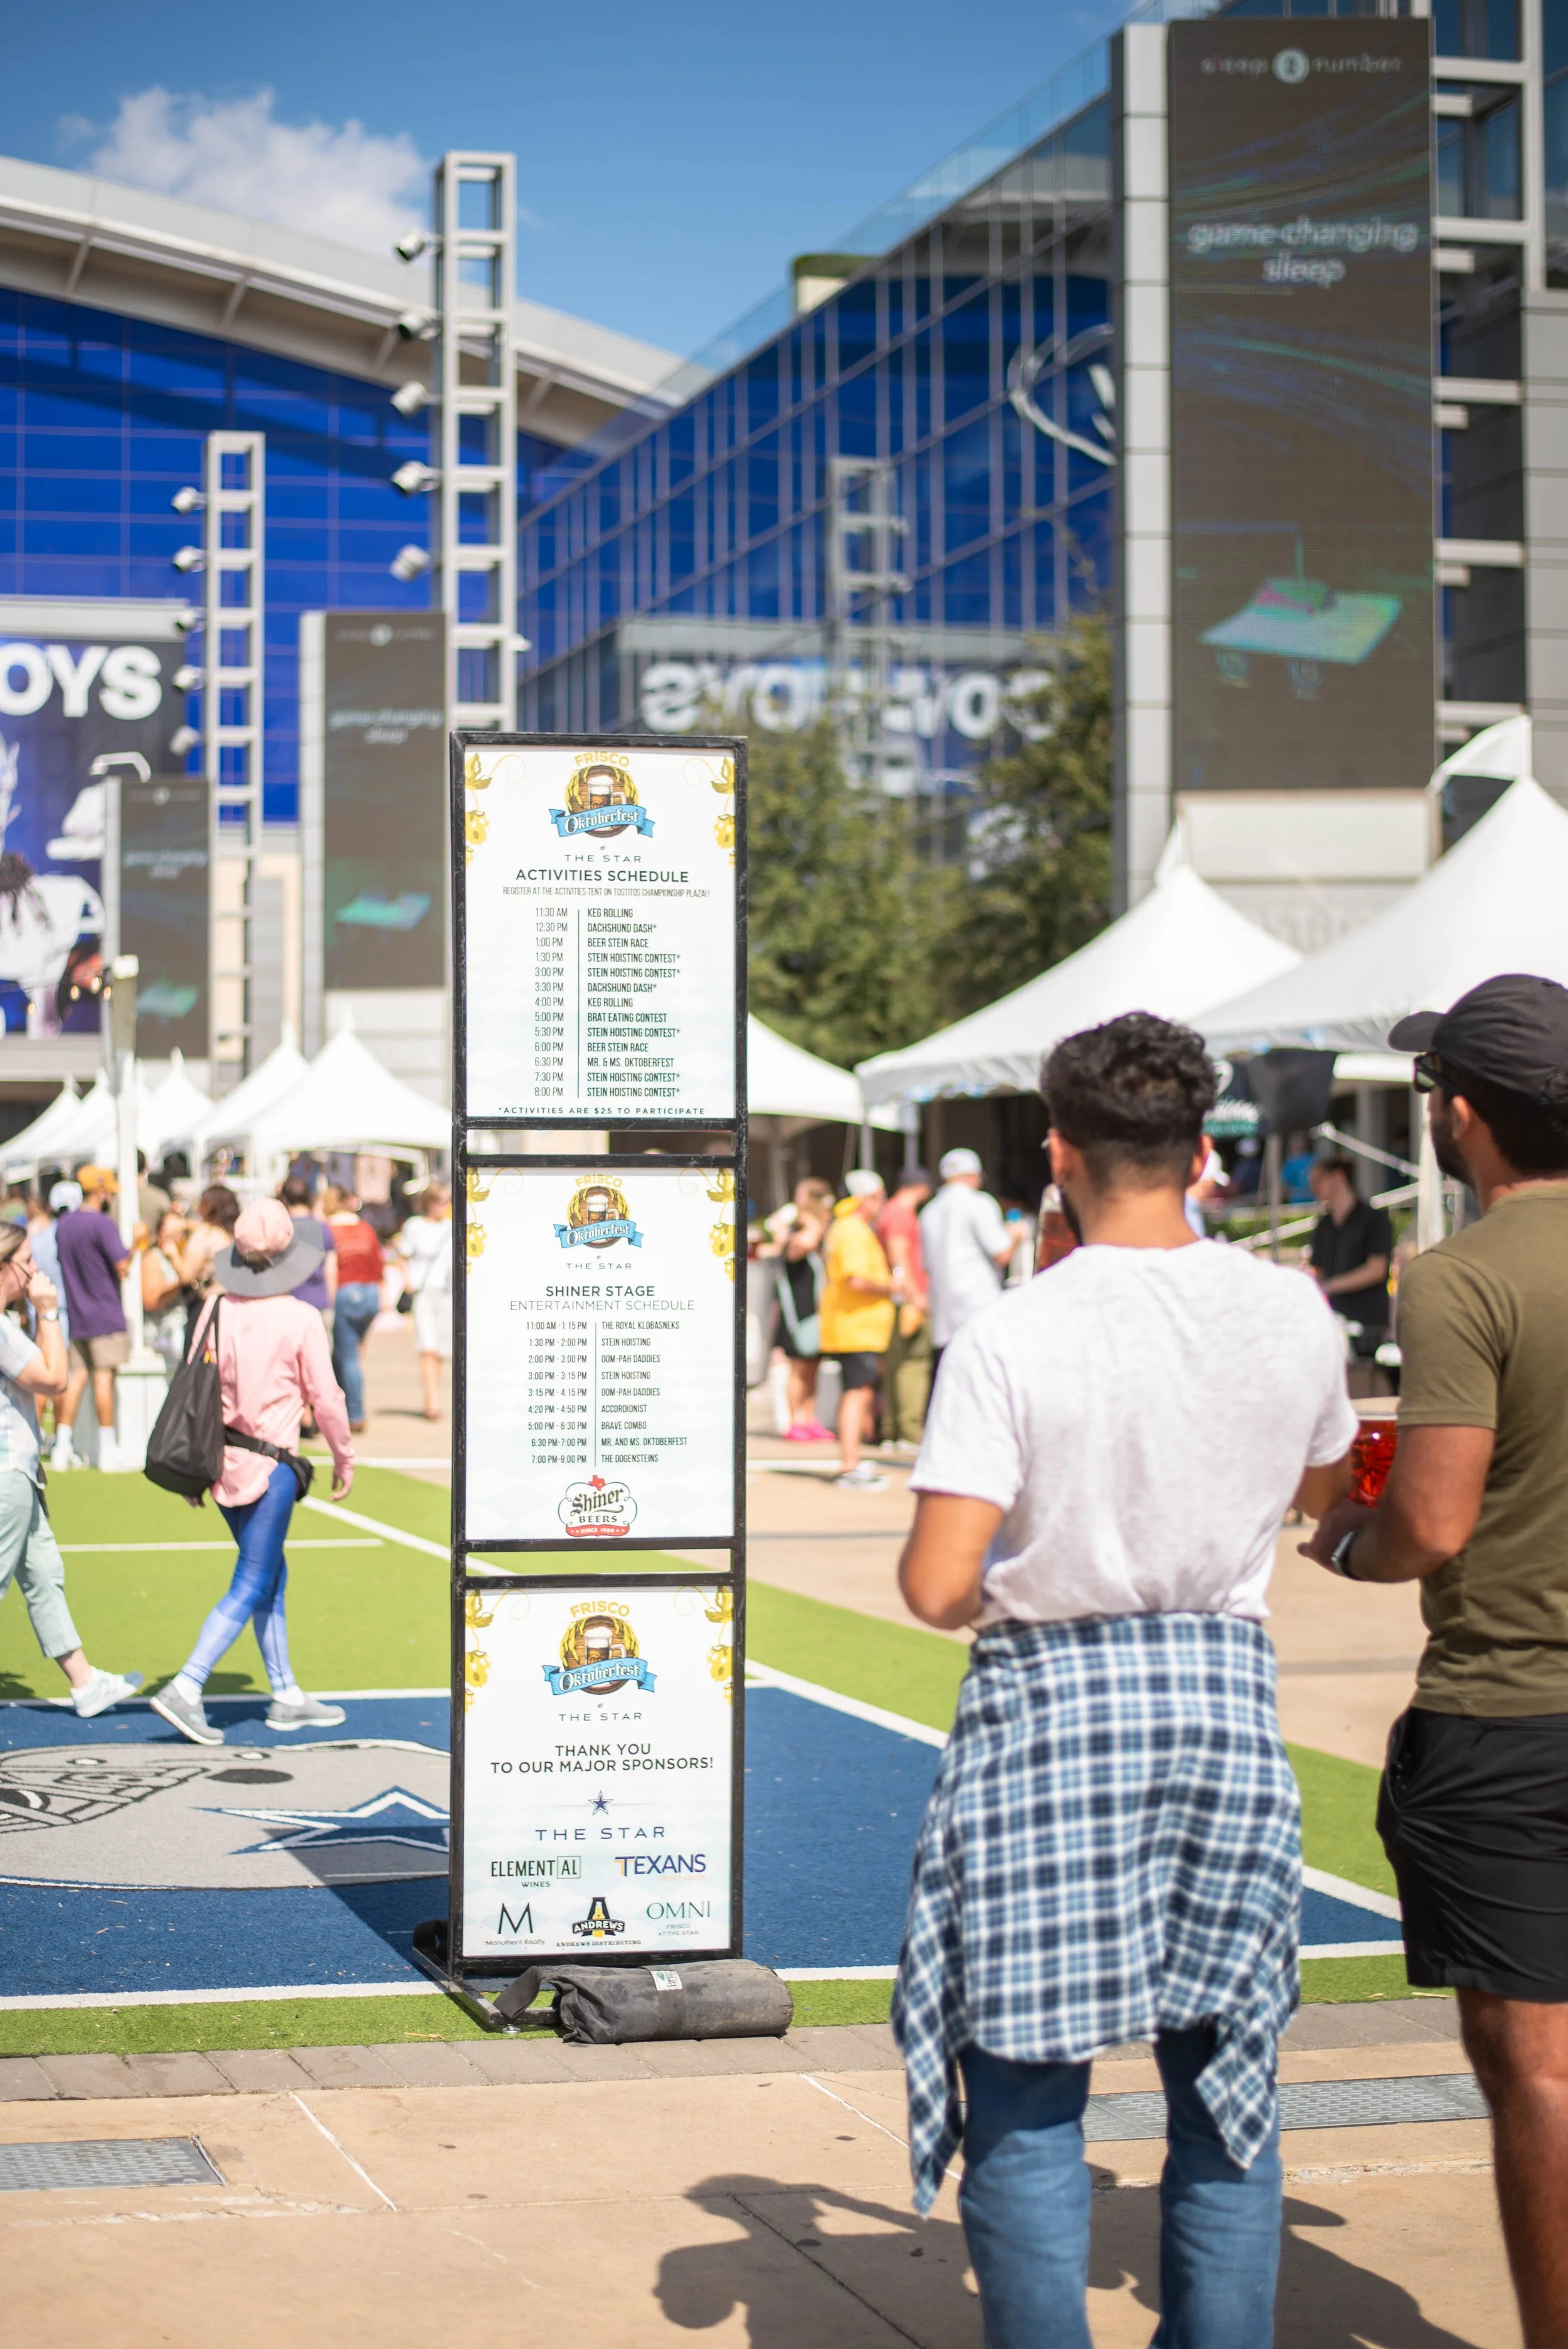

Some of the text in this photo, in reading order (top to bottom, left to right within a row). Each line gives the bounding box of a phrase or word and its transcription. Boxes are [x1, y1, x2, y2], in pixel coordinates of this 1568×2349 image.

[574, 751, 630, 768] FRISCO
[565, 807, 639, 835] Oktoberfest
[516, 869, 688, 883] ACTIVITIES SCHEDULE
[555, 888, 586, 896] ACTIVITIES
[614, 888, 640, 896] TOSTITOS
[642, 889, 684, 897] CHAMPIONSHIP
[536, 908, 568, 916] 11:30 AM
[588, 908, 633, 918] KEG ROLLING
[536, 923, 568, 931] 12:30 PM
[588, 923, 631, 933] DACHSHUND
[536, 937, 563, 946] 1:00 PM
[588, 938, 649, 948] BEER STEIN RACE
[536, 952, 563, 962] 1:30 PM
[588, 953, 608, 962] STEIN
[610, 953, 642, 962] HOISTING
[535, 967, 563, 977] 3:00 PM
[588, 968, 608, 977] STEIN
[610, 968, 642, 977] HOISTING
[535, 982, 563, 992] 3:30 PM
[588, 983, 631, 992] DACHSHUND
[535, 997, 563, 1006] 4:00 PM
[588, 998, 633, 1007] KEG ROLLING
[535, 1012, 563, 1022] 5:00 PM
[588, 1013, 667, 1022] BRAT EATING CONTEST
[535, 1027, 563, 1036] 5:30 PM
[588, 1027, 608, 1037] STEIN
[610, 1028, 642, 1037] HOISTING
[535, 1042, 563, 1051] 6:00 PM
[588, 1042, 649, 1052] BEER STEIN RACE
[535, 1057, 563, 1066] 6:30 PM
[588, 1058, 674, 1067] MR. & MS. OKTOBERFEST
[535, 1072, 563, 1081] 7:30 PM
[587, 1073, 607, 1081] STEIN
[610, 1073, 642, 1082] HOISTING
[535, 1087, 563, 1096] 8:00 PM
[587, 1088, 607, 1096] STEIN
[610, 1088, 642, 1096] HOISTING
[575, 1174, 623, 1188] FRISCO
[567, 1221, 631, 1246] Oktoberfest
[546, 1286, 654, 1296] SHINER STAGE
[511, 1300, 694, 1310] ENTERTAINMENT SCHEDULE
[638, 1321, 679, 1329] KLOBASNEKS
[602, 1338, 650, 1346] STEIN HOISTING
[622, 1371, 650, 1379] HOISTING
[601, 1388, 631, 1396] OOM-PAH
[601, 1404, 647, 1413] ACCORDIONIST
[601, 1421, 647, 1429] BRAVE COMBO
[615, 1438, 628, 1446] AND
[630, 1438, 641, 1446] MS.
[601, 1454, 658, 1463] THE DOGENSTEINS
[570, 1488, 624, 1517] Shiner
[569, 1600, 630, 1618] FRISCO
[559, 1658, 639, 1692] Oktoberfest
[600, 1712, 642, 1721] STAR
[555, 1744, 650, 1756] THANK YOU
[490, 1757, 712, 1773] TO OUR MAJOR SPONSORS!
[535, 1827, 664, 1841] THE STAR
[615, 1854, 706, 1877] TEXANS
[647, 1901, 711, 1919] OMNI
[573, 1920, 624, 1933] ANDREWS
